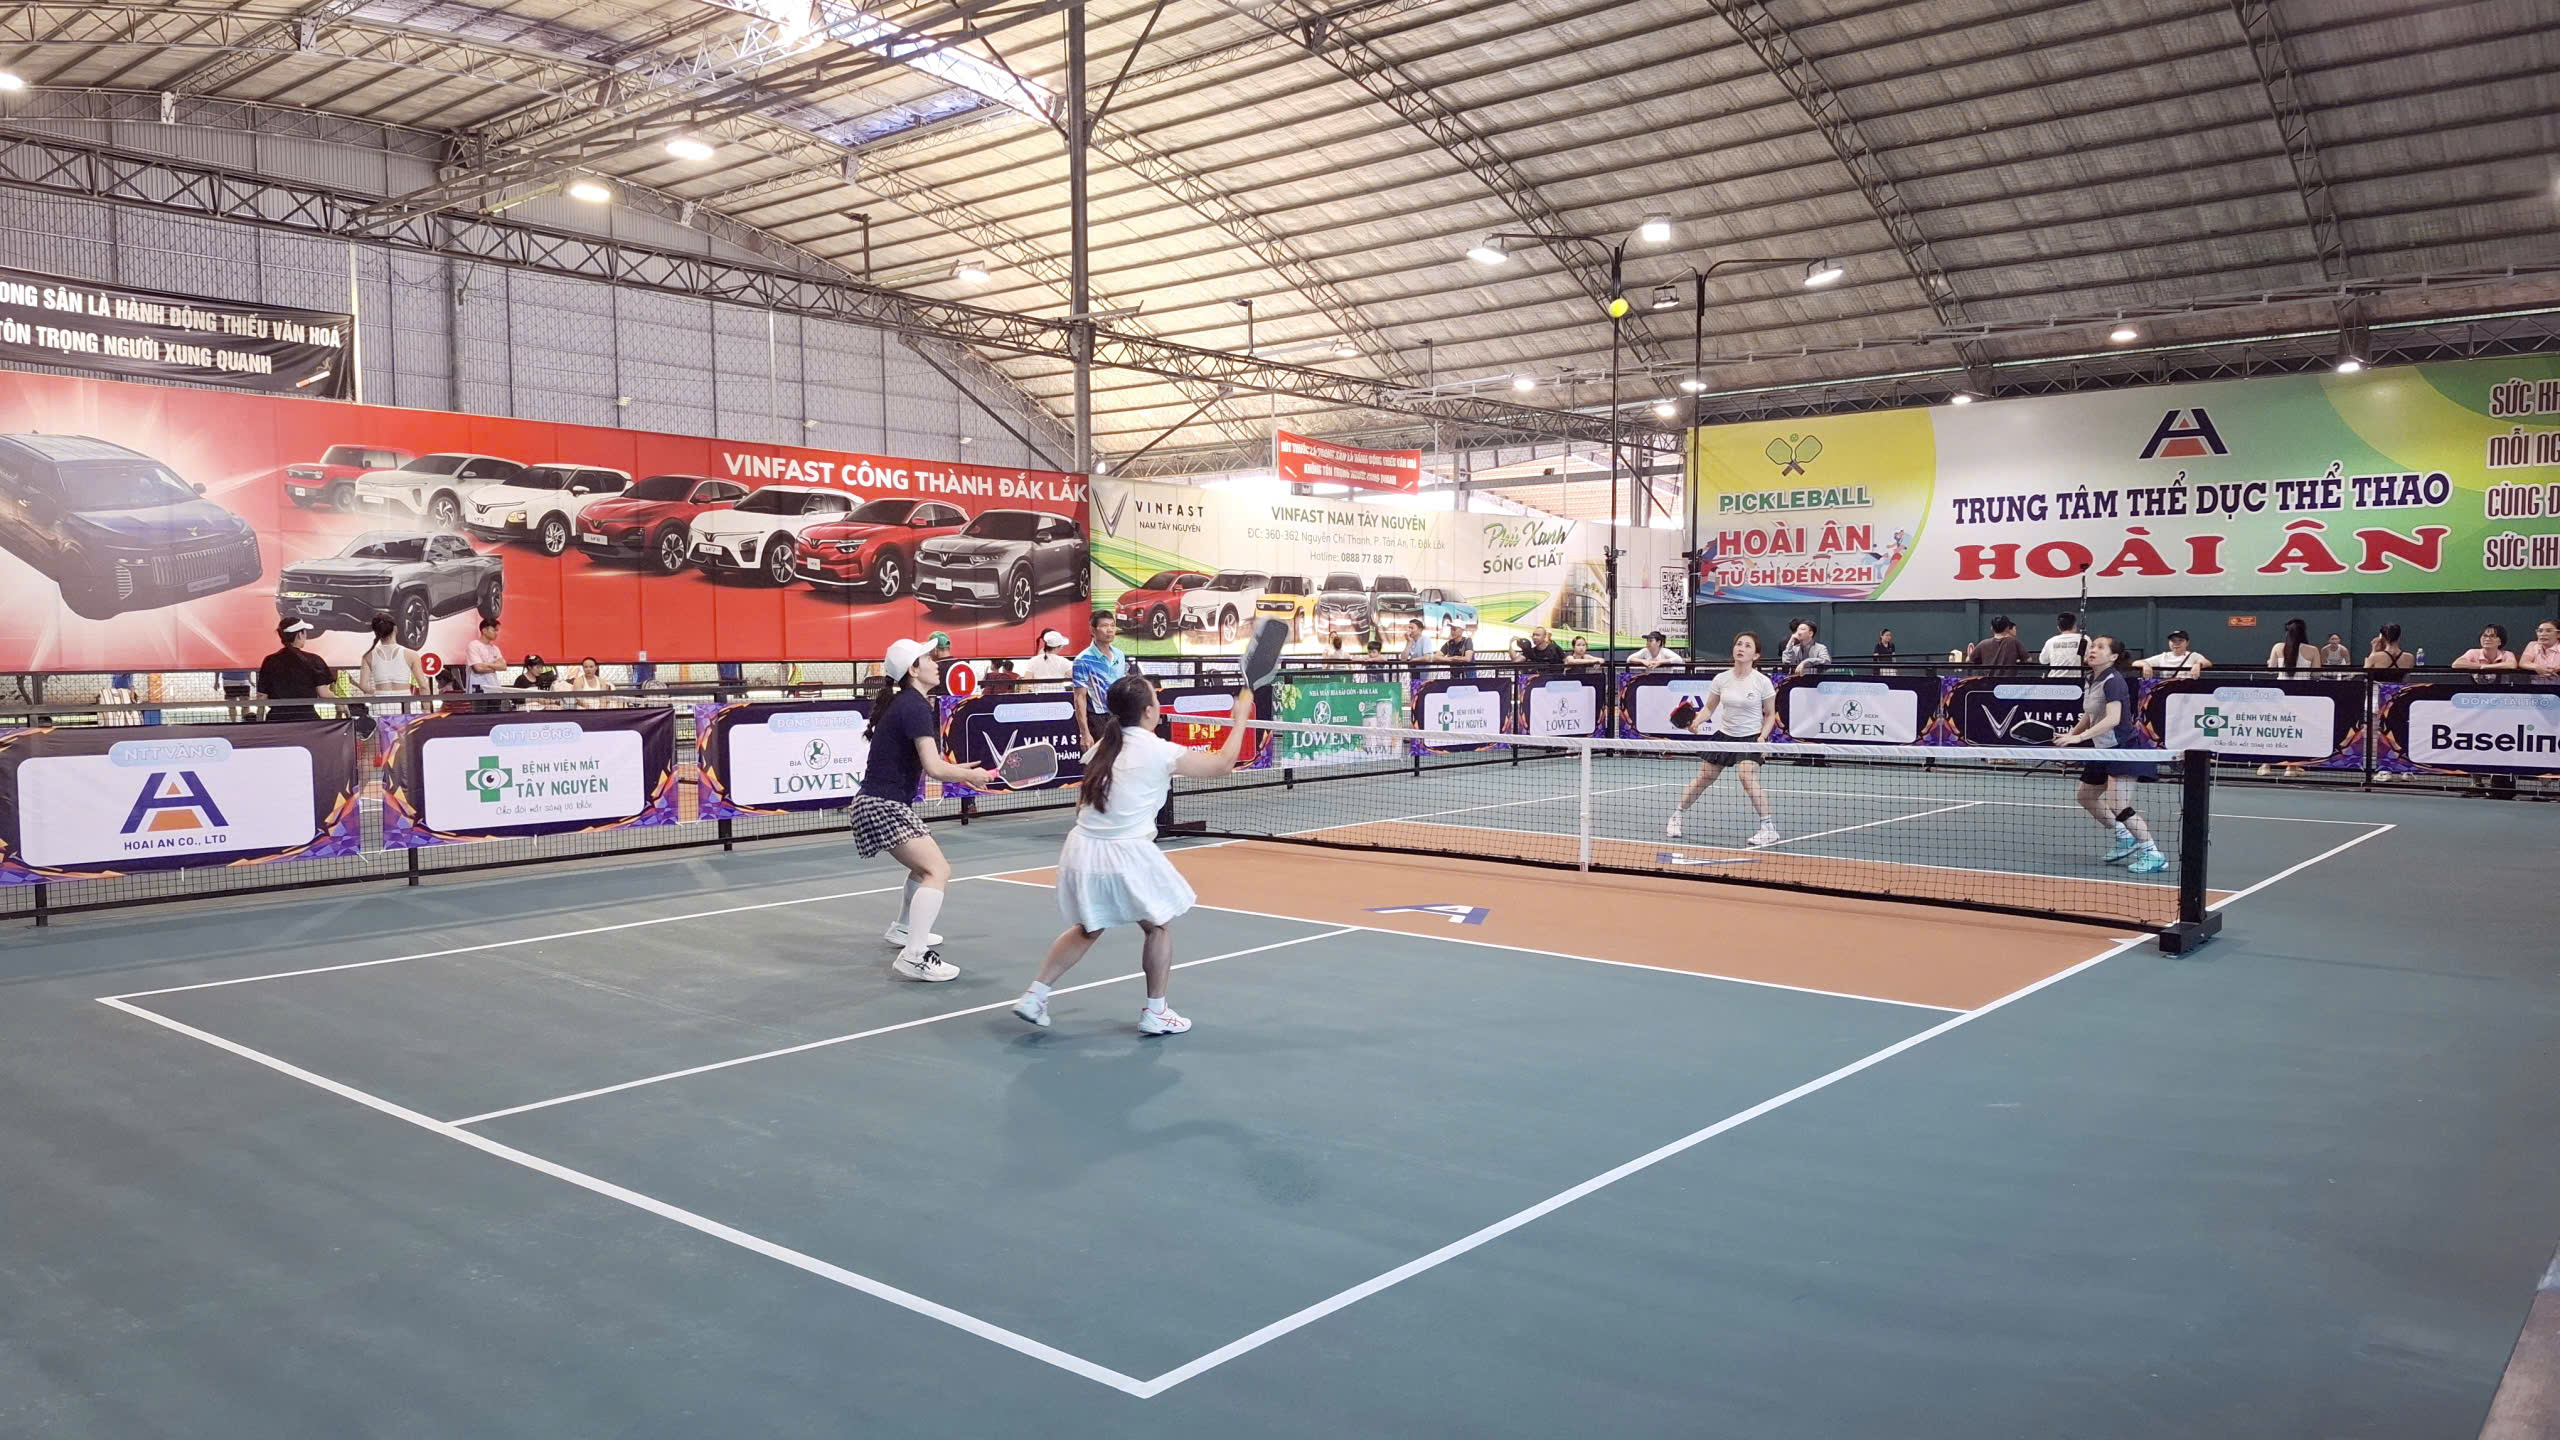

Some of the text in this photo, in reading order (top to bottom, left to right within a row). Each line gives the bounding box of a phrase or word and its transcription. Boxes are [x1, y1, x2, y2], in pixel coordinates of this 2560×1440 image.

[43, 287, 83, 314] SÂN
[88, 292, 111, 318] LÀ
[115, 297, 165, 325] HÀNH
[169, 305, 217, 333] ĐỘNG
[221, 313, 268, 340] THIẾU
[273, 320, 304, 344] VĂN
[309, 325, 341, 349] HOÁ
[35, 325, 99, 355] TRỌNG
[104, 335, 160, 361] NGƯỜI
[163, 343, 212, 368] XUNG
[216, 349, 272, 375] QUANH
[2492, 379, 2531, 415] SỨC
[723, 452, 1088, 503] VINFAST CÔNG THÀNH ĐẮK LẮK
[1719, 487, 1871, 512] PICKLEBALL
[1953, 462, 2450, 524] TRUNG TÂM THỂ DỤC THỂ THAO
[2488, 483, 2540, 517] CÙNG
[1136, 500, 1204, 518] VINFAST
[1272, 506, 1426, 531] VINFAST NAM TÂY NGUYÊN
[1140, 520, 1201, 533] NAM TÂY NGUYÊN
[1265, 528, 1299, 541] 360-362
[1302, 531, 1331, 544] Nguyễn
[1333, 533, 1345, 544] Chí
[1522, 520, 1577, 547] Xanh
[1719, 520, 1872, 556] HOÀI ÂN
[1310, 552, 1394, 564] Hotline: 0888 77 88 77
[1483, 548, 1564, 574] SỐNG CHẤT
[1953, 519, 2450, 580] HOÀI ÂN
[2486, 533, 2526, 568] SỨC
[1718, 564, 1872, 586] TỪ 5H ĐẾN 22H
[425, 657, 435, 671] 2
[958, 671, 966, 692] 1
[1819, 721, 1886, 736] LÖWEN
[2236, 712, 2257, 722] BỆNH
[2259, 712, 2277, 723] VIỆN
[1024, 734, 1082, 747] VINFAS
[2230, 724, 2303, 739] TÂY NGUYÊN
[2432, 724, 2560, 752] Baselin
[124, 747, 160, 761] NTT
[522, 760, 550, 776] BỆNH
[553, 758, 577, 774] VIỆN
[516, 775, 609, 798] TÂY NGUYÊN
[773, 771, 862, 794] LÖWEN
[124, 834, 227, 851] HOAI AN CO., LTD
